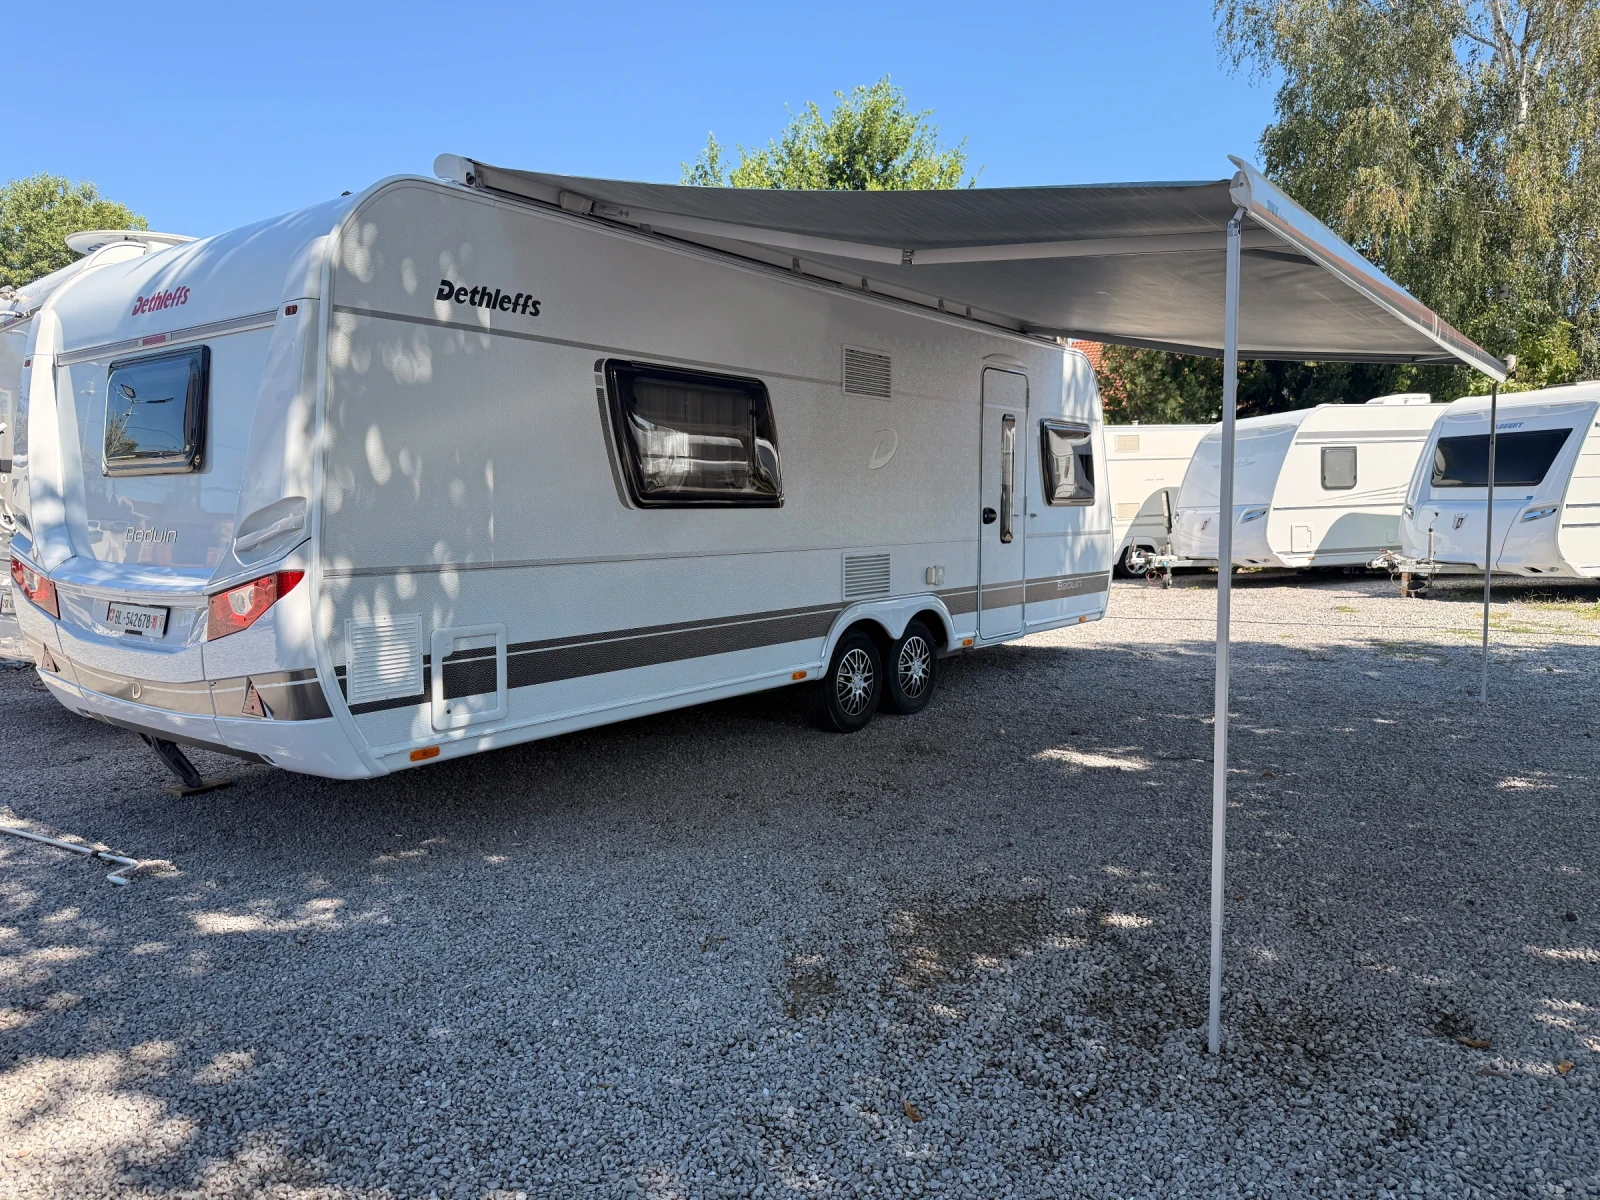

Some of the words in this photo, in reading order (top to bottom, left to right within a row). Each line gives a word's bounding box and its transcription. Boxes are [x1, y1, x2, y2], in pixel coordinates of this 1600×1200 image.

[131, 285, 191, 317] Dethleffs
[436, 278, 542, 317] Dethleffs
[125, 526, 178, 543] Beduin
[1056, 580, 1083, 591] Beduin
